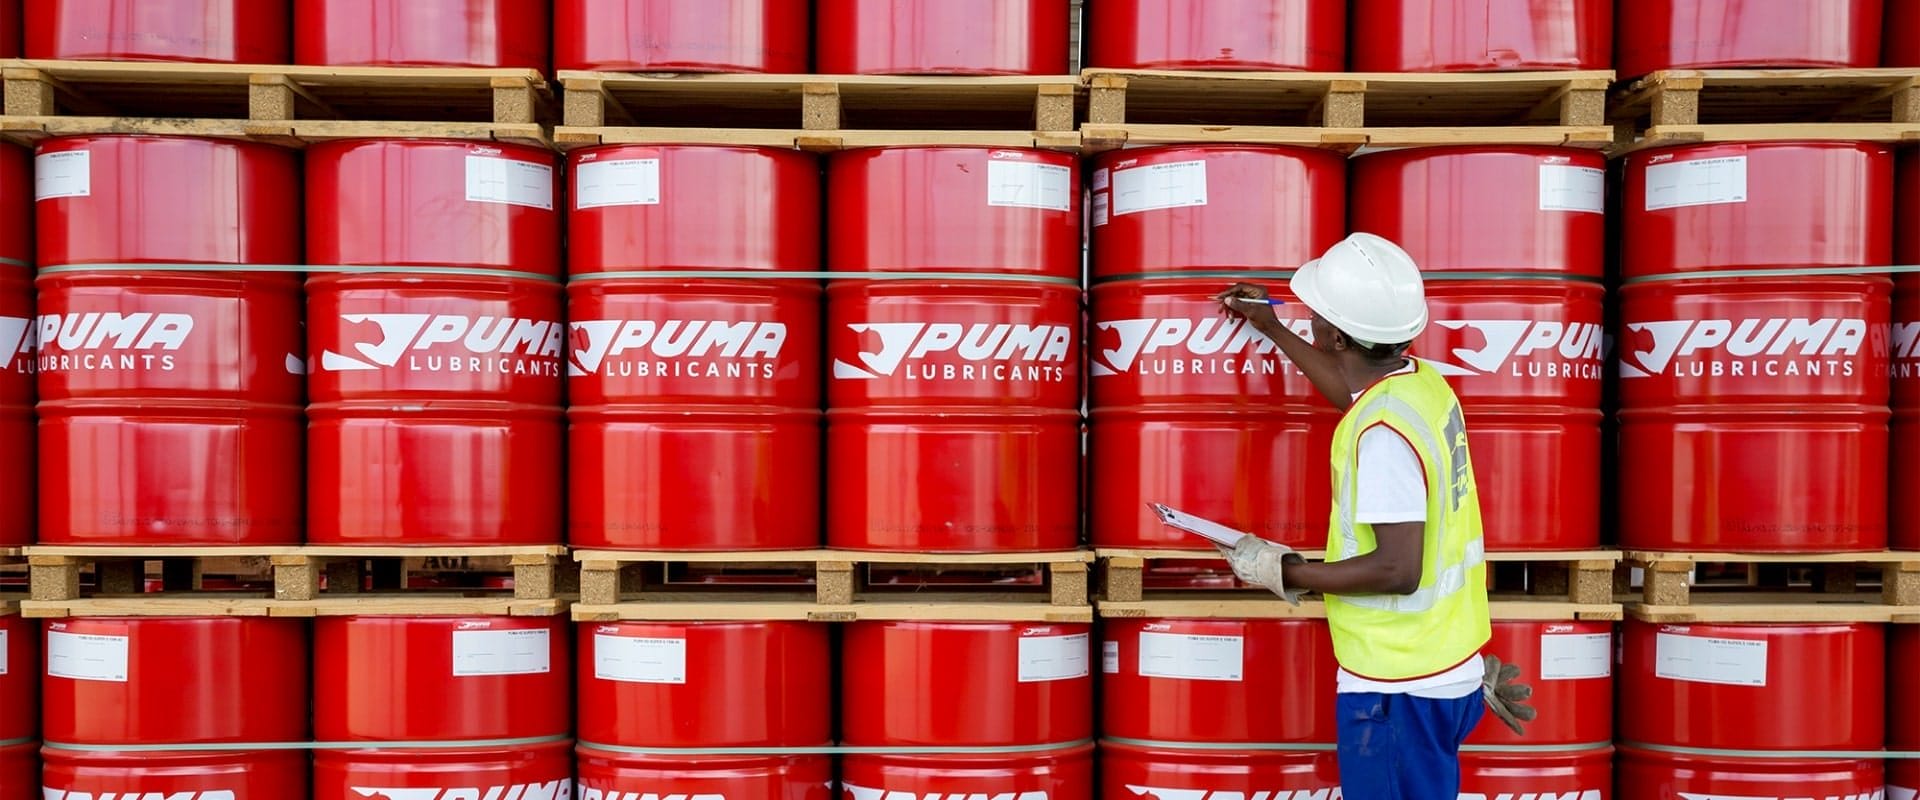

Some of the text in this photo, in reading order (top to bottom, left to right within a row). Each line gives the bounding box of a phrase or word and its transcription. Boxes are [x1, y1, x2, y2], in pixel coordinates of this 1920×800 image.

[39, 312, 195, 351] PUMA
[411, 314, 563, 358] PUMA
[607, 319, 788, 359] PUMA
[907, 322, 1071, 363] PUMA
[1514, 320, 1604, 361] PUM
[1676, 317, 1867, 357] PUMA
[410, 356, 560, 378] LUBRICANTS
[605, 360, 775, 380] LUBRICANTS
[905, 363, 1064, 383] LUBRICANTS
[1139, 357, 1304, 376] LUBRICANT
[1674, 360, 1853, 378] LUBRICANTS
